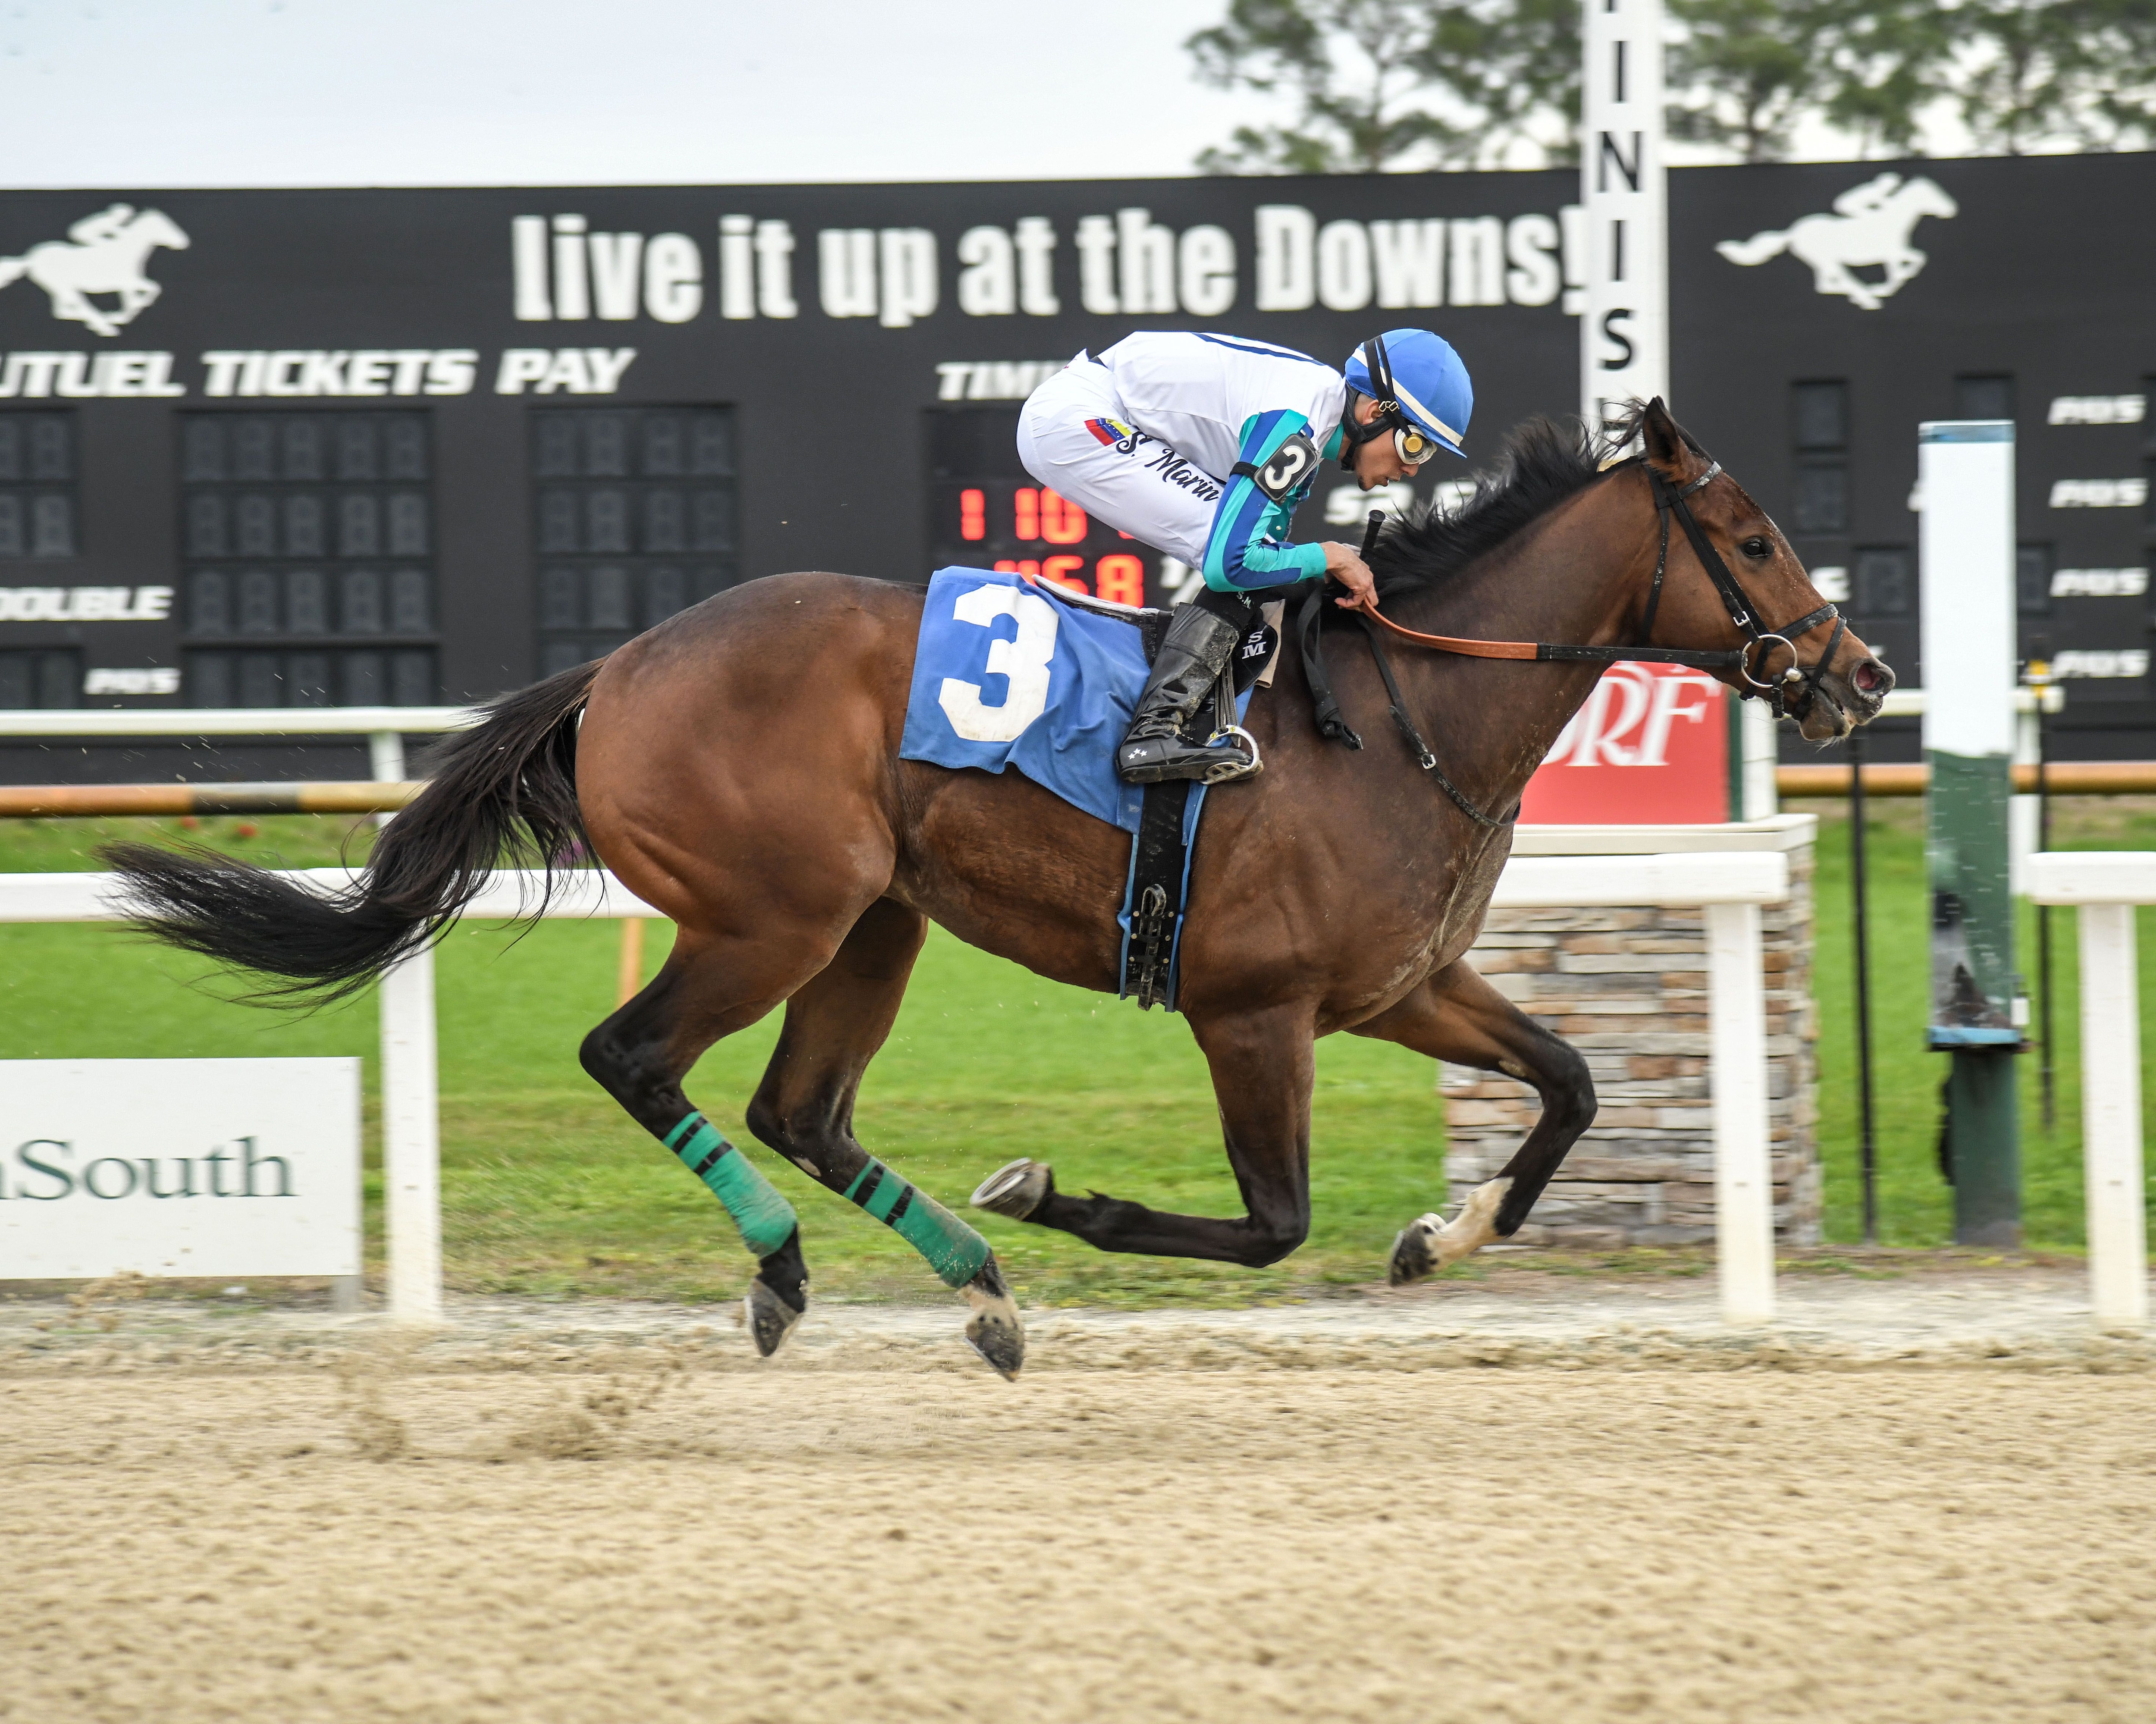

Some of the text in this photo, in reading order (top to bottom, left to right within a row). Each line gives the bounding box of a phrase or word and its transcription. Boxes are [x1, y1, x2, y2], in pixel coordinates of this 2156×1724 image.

[1595, 0, 1645, 458] INIS
[719, 214, 798, 320] it
[818, 228, 939, 328] up
[958, 216, 1059, 316] at
[1075, 207, 1237, 316] the
[1255, 204, 1589, 316] Downs!
[201, 349, 479, 397] TICKETS
[495, 347, 636, 395] PAY
[1116, 431, 1219, 501] S. Marin
[1265, 445, 1306, 490] 3
[938, 583, 1059, 742] 3
[1241, 641, 1267, 660] M
[1248, 630, 1263, 644] S
[0, 1136, 298, 1201] South
